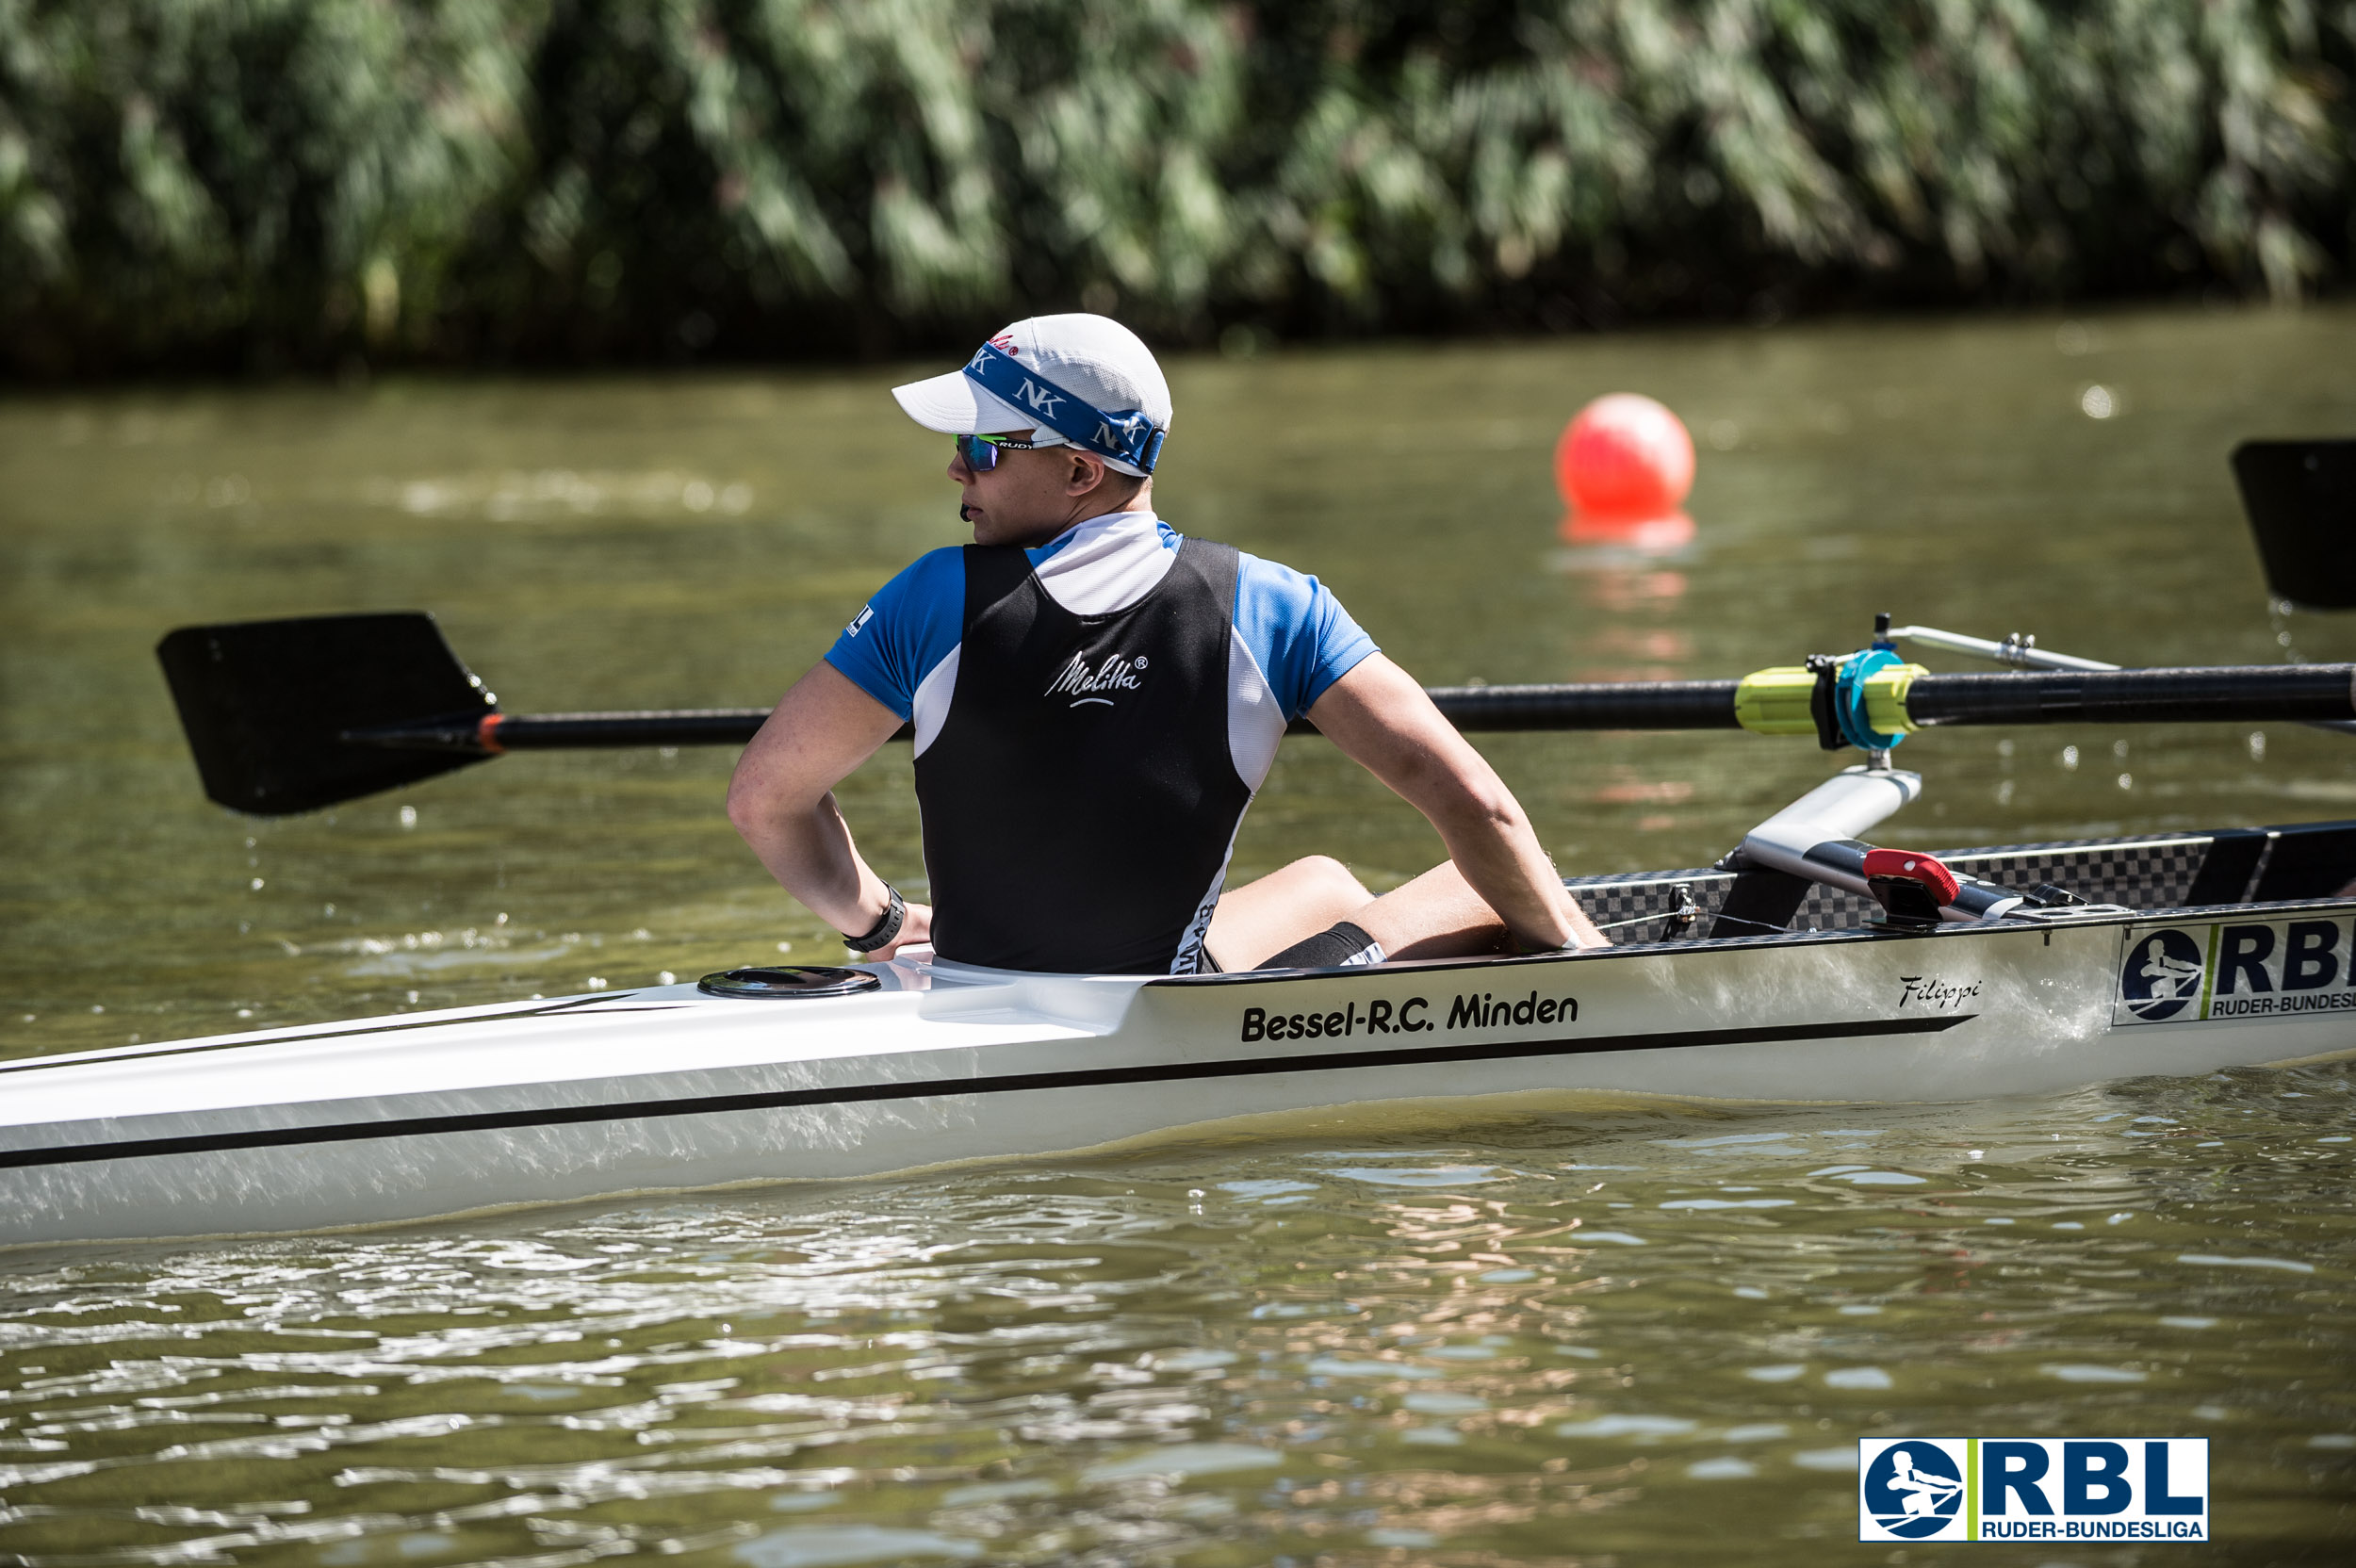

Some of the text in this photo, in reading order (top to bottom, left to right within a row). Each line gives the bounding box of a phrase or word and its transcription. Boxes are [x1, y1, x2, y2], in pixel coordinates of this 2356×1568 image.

[1011, 376, 1067, 420] NK
[2215, 918, 2356, 996] RB
[1240, 989, 1579, 1043] Bessel-R.C. Minden
[1898, 975, 1983, 1009] Filippi
